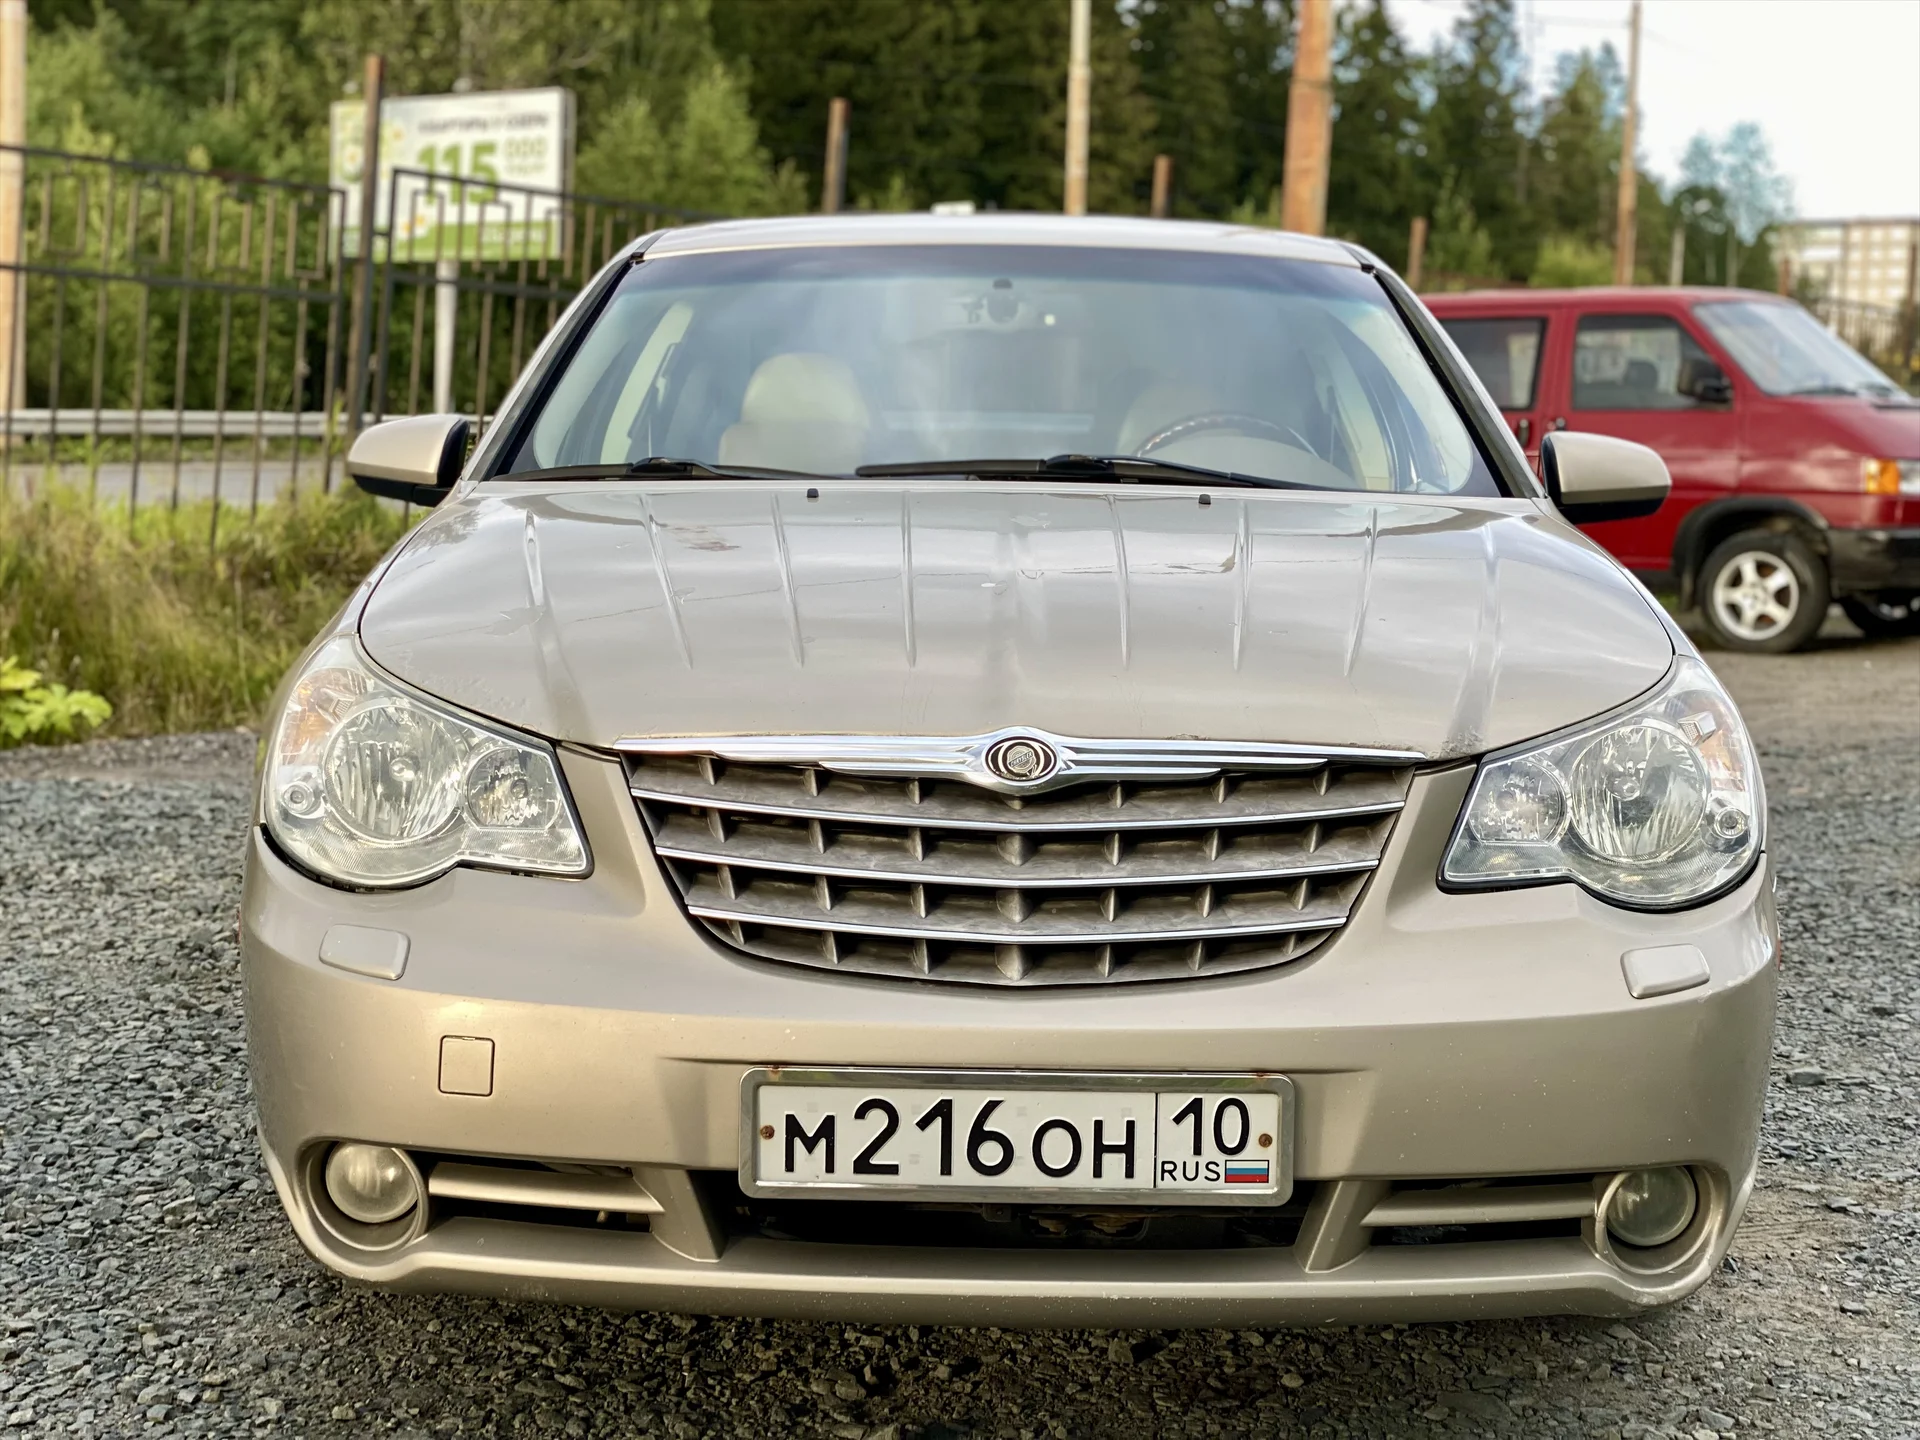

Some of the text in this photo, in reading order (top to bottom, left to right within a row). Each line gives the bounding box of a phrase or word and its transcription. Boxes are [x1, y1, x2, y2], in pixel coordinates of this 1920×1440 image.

[418, 142, 498, 205] 115
[1172, 1097, 1250, 1156] 10
[1160, 1160, 1221, 1182] RUS
